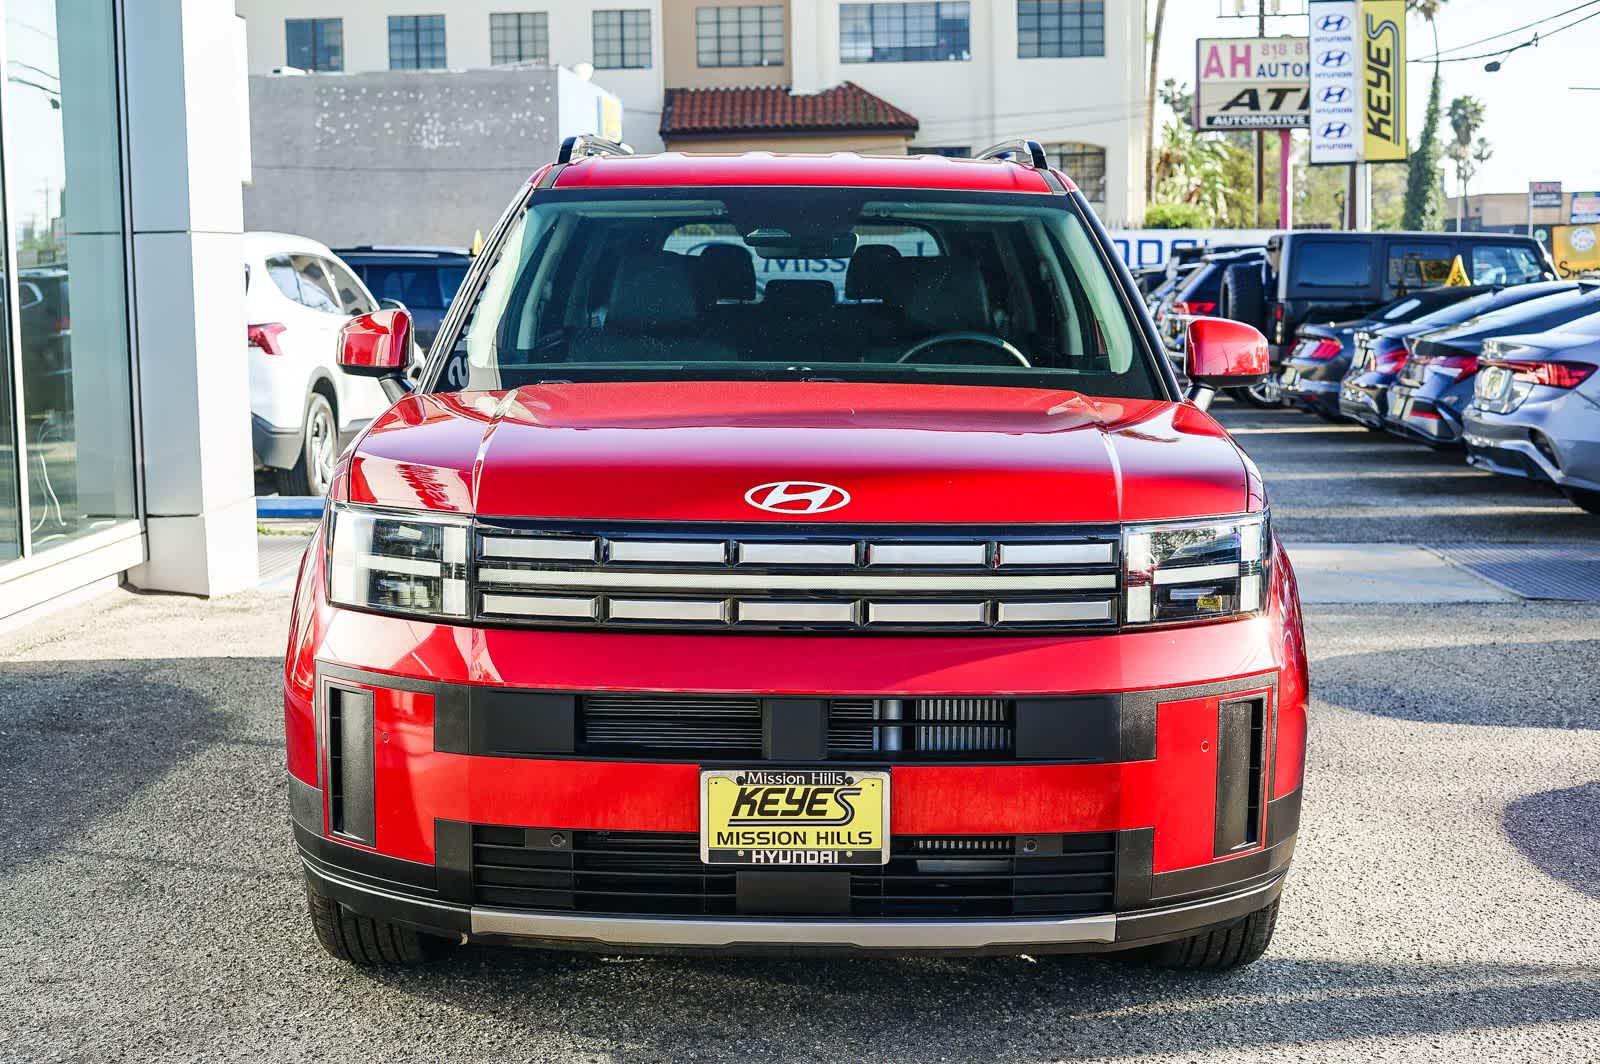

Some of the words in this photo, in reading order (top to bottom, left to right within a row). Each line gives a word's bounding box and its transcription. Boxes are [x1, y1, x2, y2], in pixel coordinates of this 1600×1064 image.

[1203, 44, 1252, 78] AH
[1366, 13, 1399, 144] KEYES
[1212, 115, 1305, 126] AUTOMOTIVE
[747, 772, 805, 785] Mission
[811, 772, 844, 785] Hills
[728, 787, 863, 827] KEYES
[717, 831, 807, 845] MISSION
[816, 831, 873, 845] HILLS
[751, 850, 839, 863] HYUNDAI
